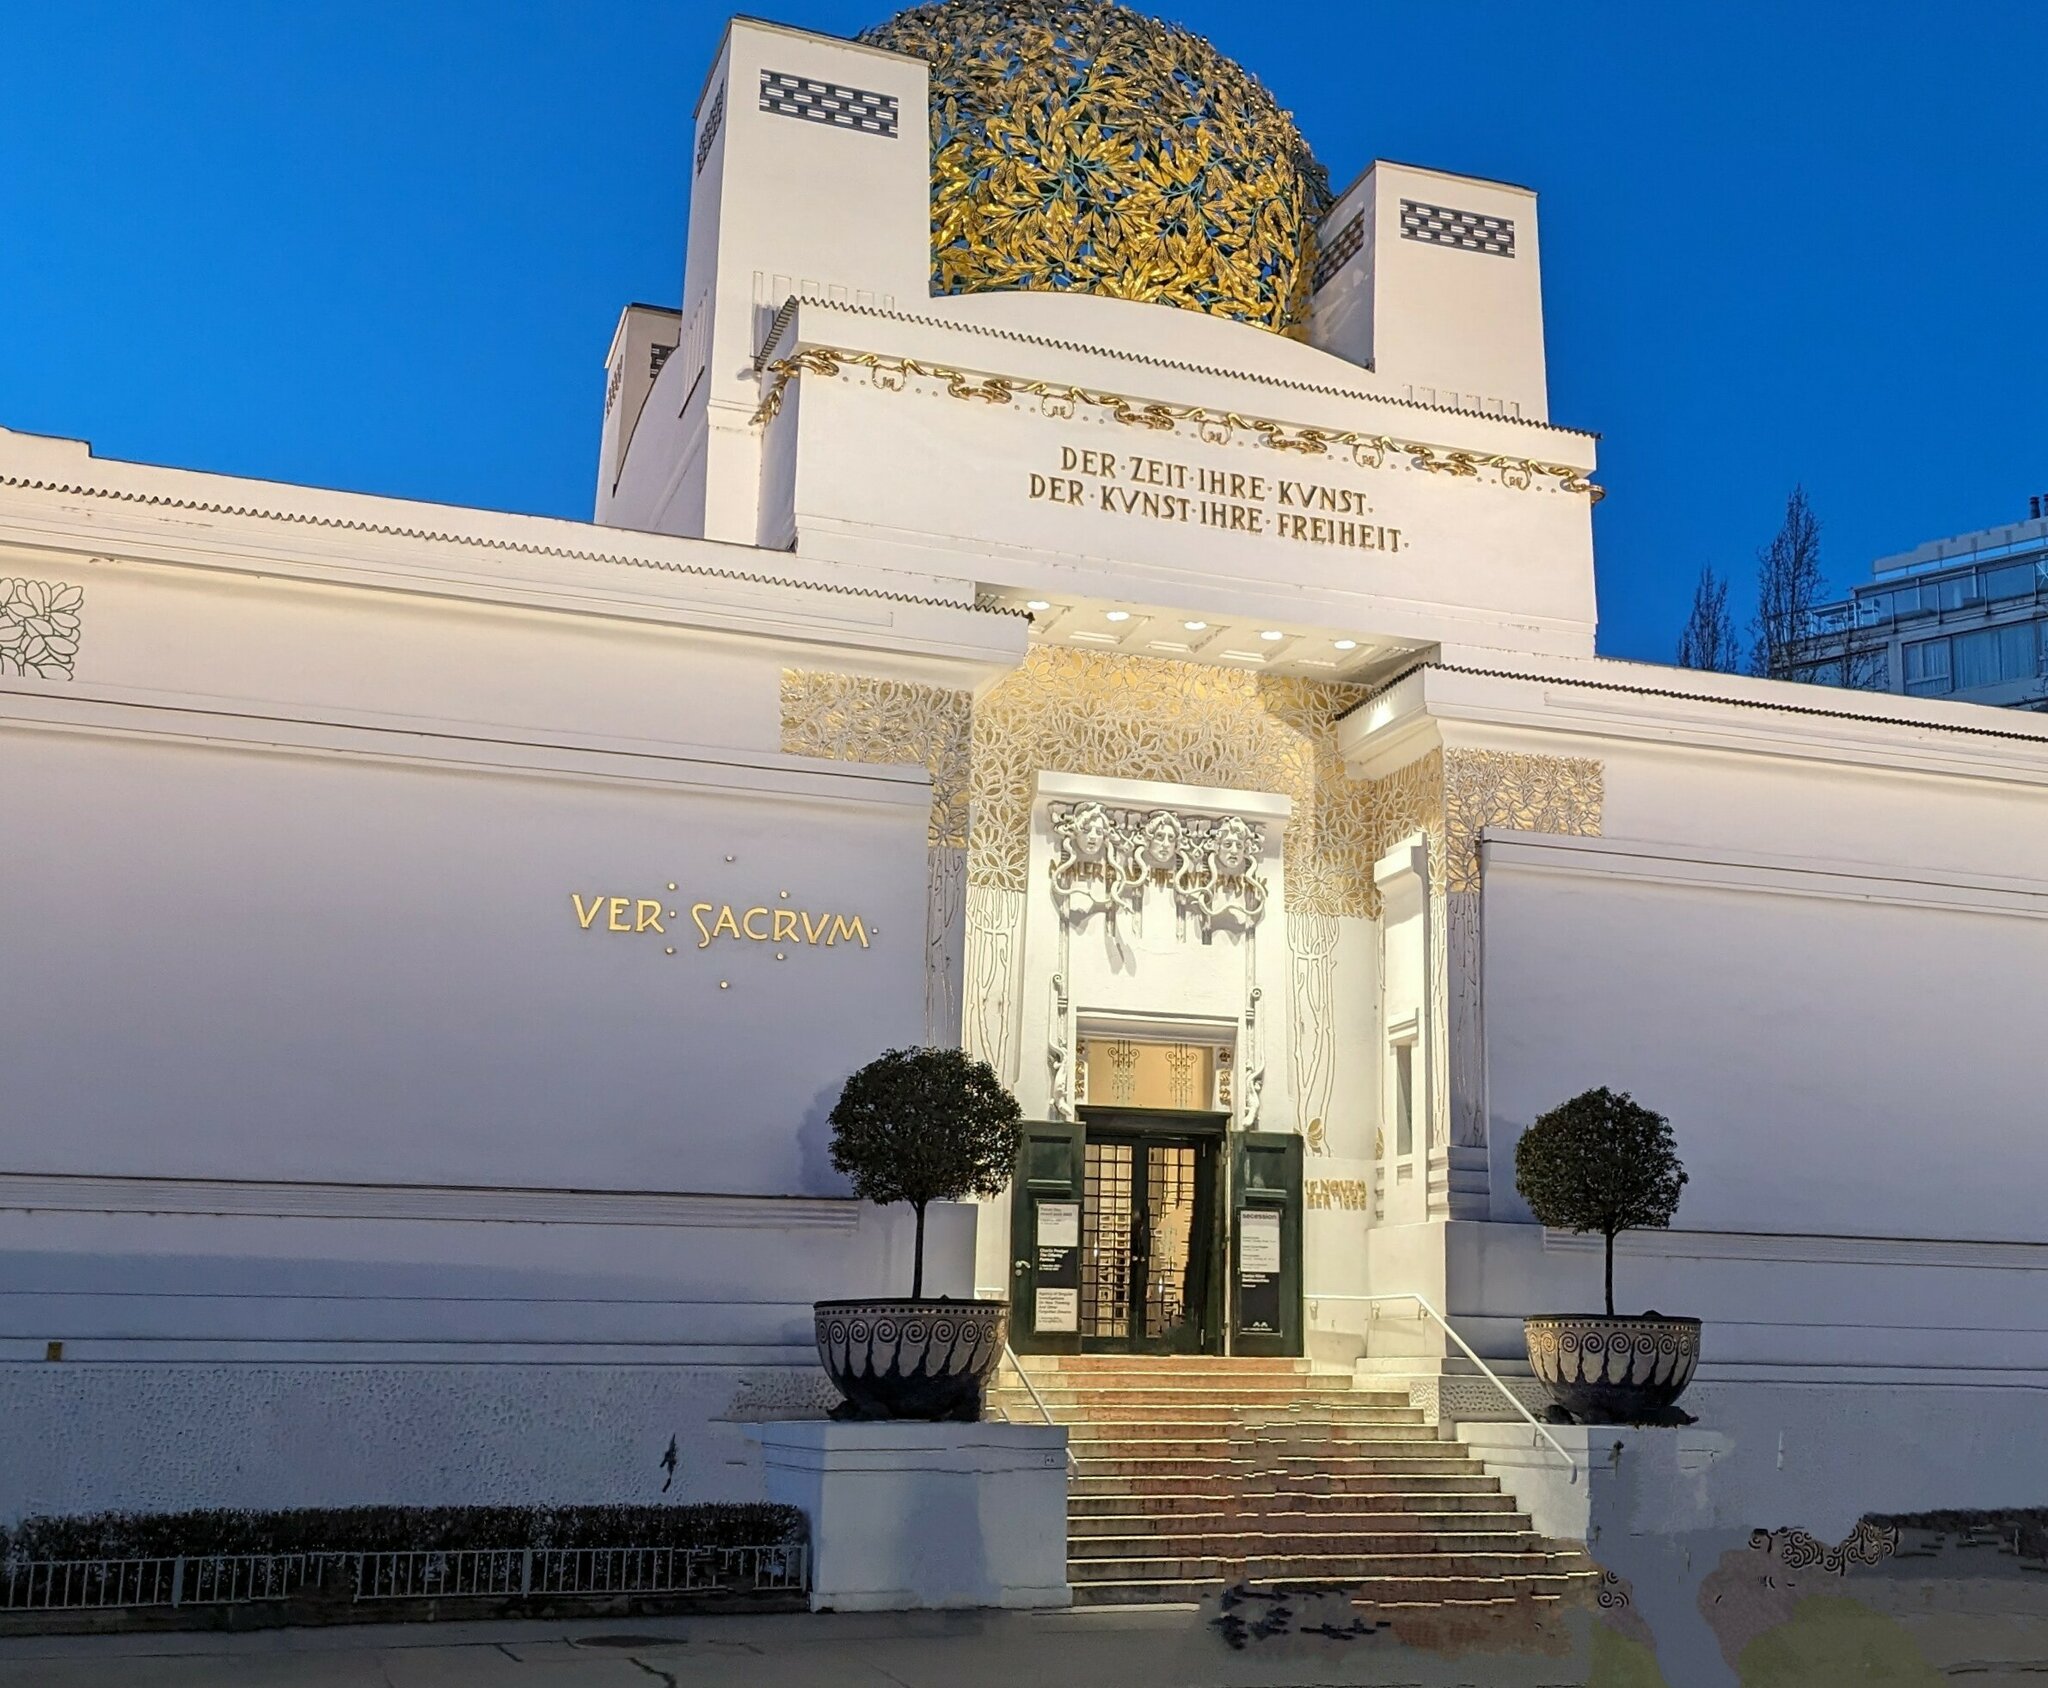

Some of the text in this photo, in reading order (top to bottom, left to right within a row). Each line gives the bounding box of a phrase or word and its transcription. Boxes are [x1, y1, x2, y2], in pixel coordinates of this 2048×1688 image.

[1060, 446, 1116, 478] DER
[1129, 456, 1187, 490] ZEIT
[1198, 467, 1265, 501] IHRE
[1029, 473, 1084, 506] DER
[1200, 501, 1263, 534] IHRE
[571, 893, 870, 949] VER SACRVM
[1242, 1212, 1277, 1220] secession
